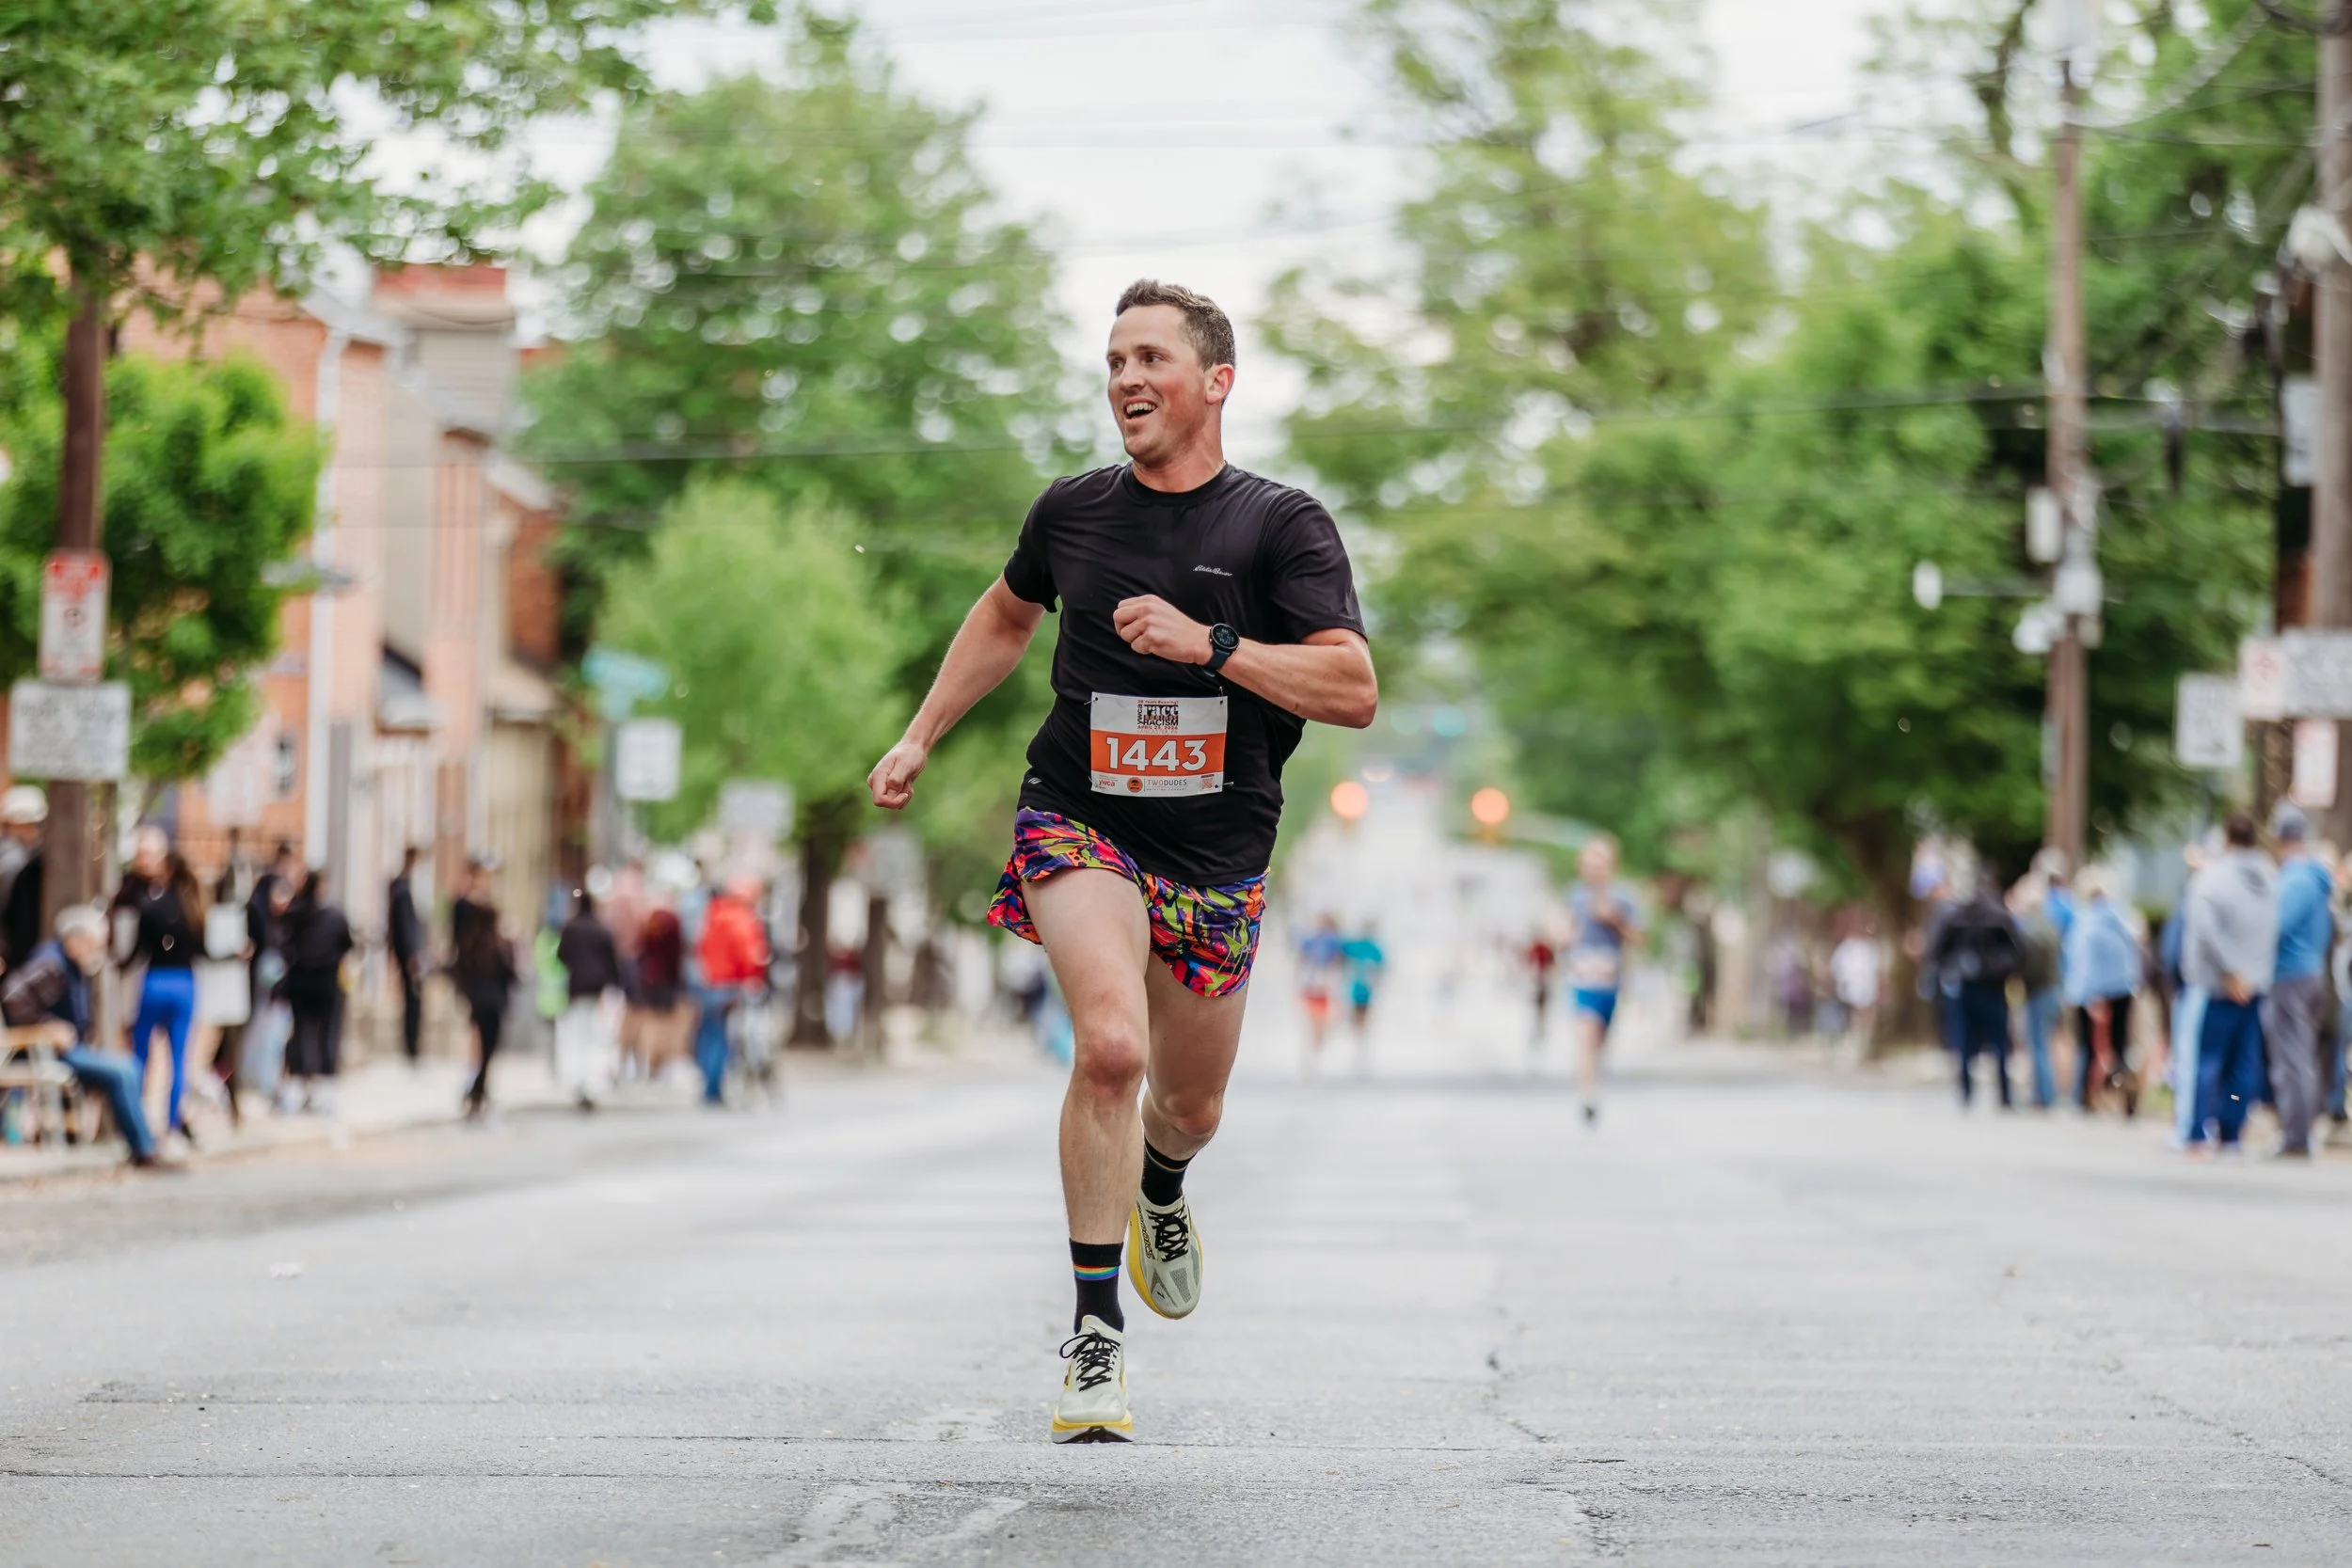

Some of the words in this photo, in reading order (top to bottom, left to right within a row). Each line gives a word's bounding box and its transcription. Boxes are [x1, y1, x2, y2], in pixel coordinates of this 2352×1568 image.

[1143, 705, 1178, 716] race
[1105, 736, 1207, 772] 1443
[1099, 779, 1116, 787] ywca
